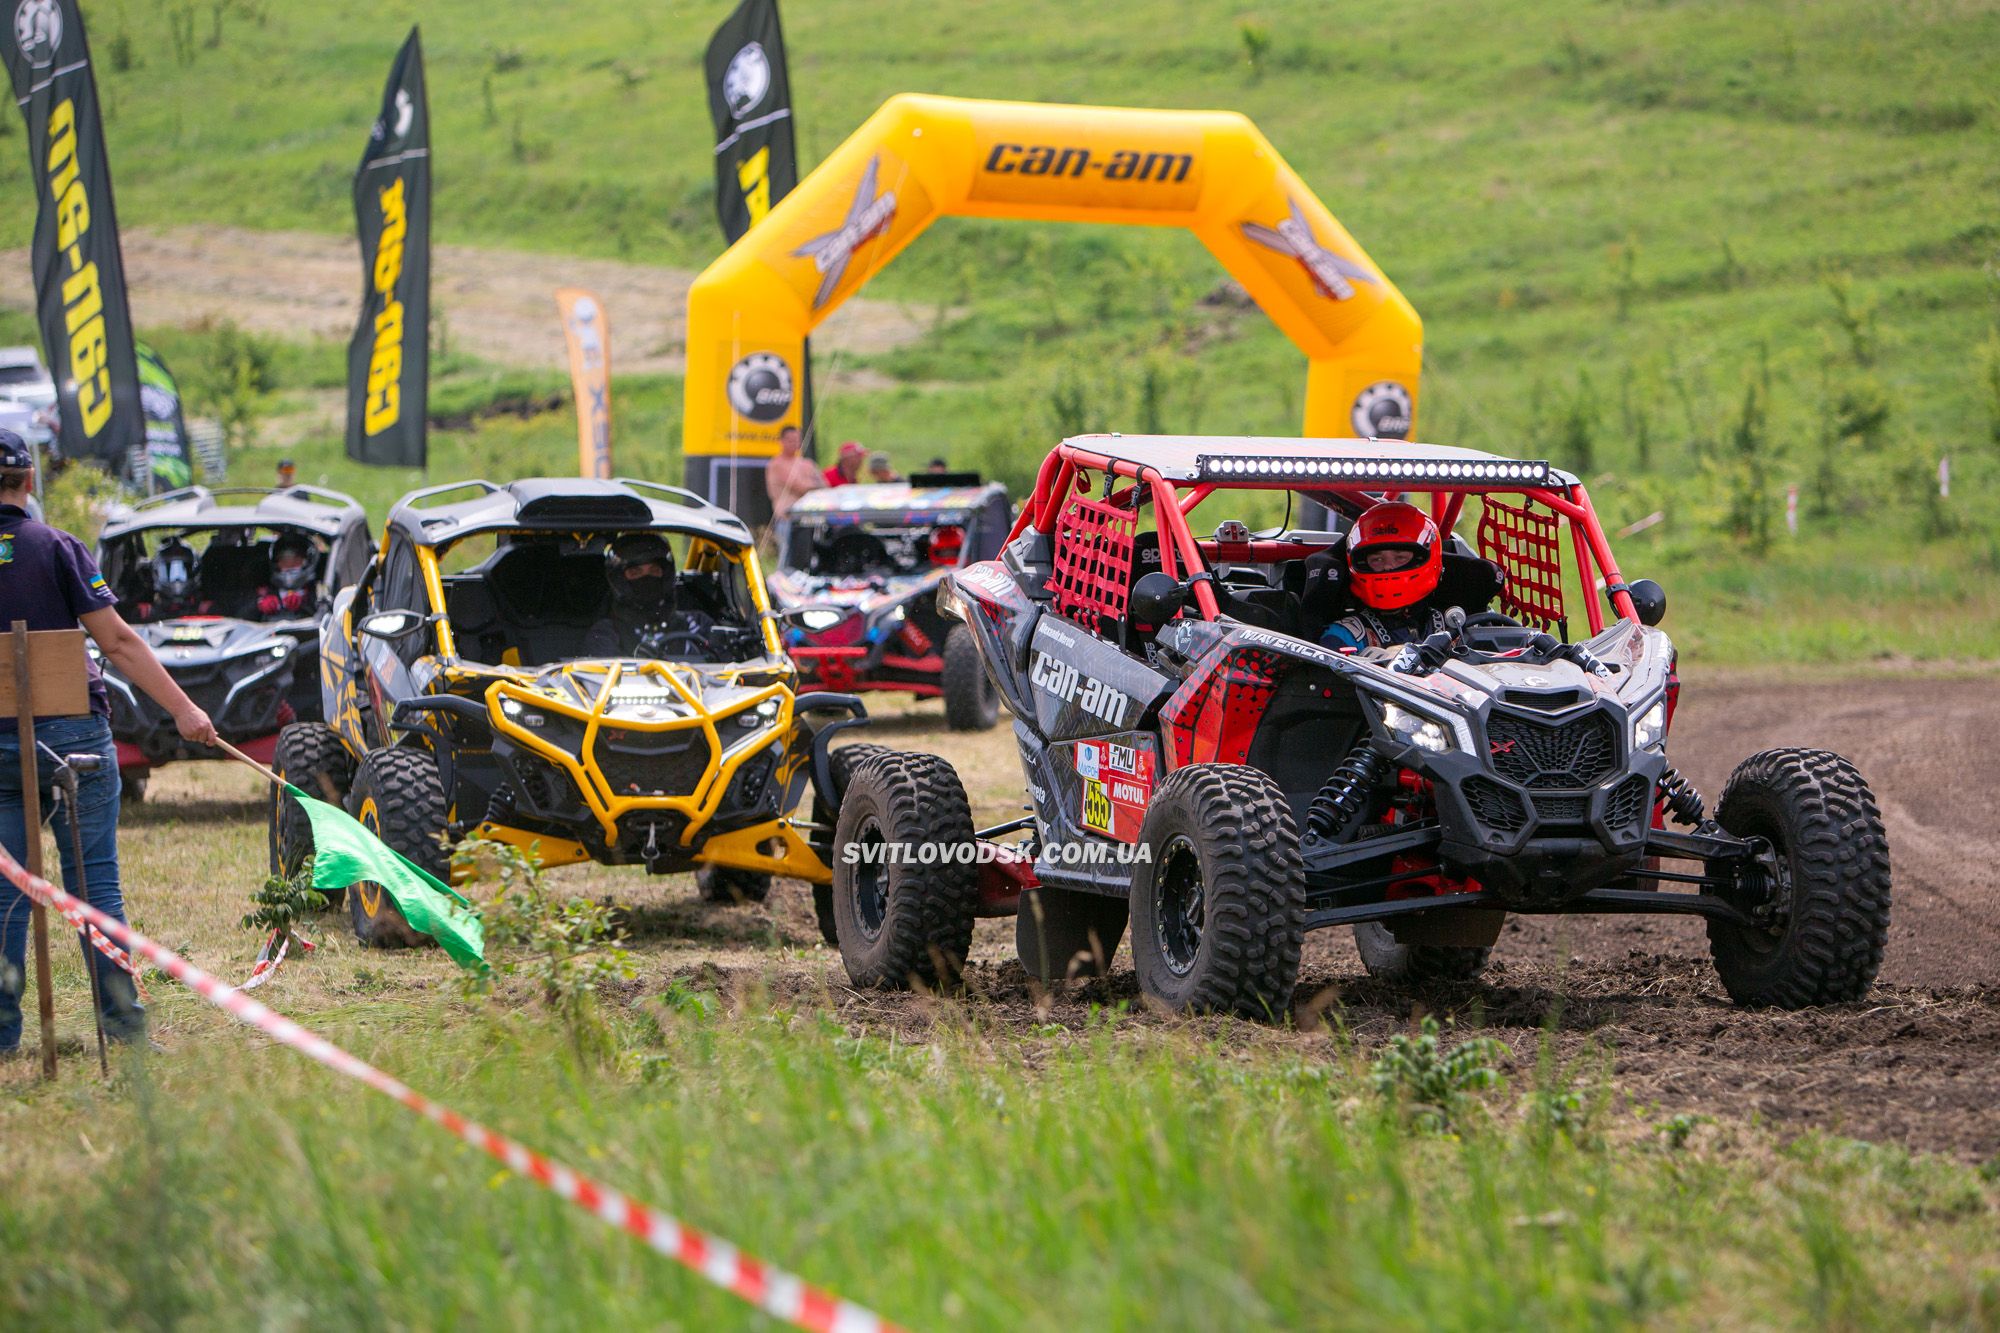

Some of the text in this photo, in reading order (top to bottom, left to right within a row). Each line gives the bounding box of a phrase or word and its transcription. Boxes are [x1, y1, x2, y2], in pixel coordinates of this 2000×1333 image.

[984, 143, 1194, 183] can-am
[1239, 629, 1329, 662] MAVERICK
[1031, 650, 1129, 727] can-am
[1085, 782, 1109, 829] 555
[1113, 782, 1145, 805] MOTUL
